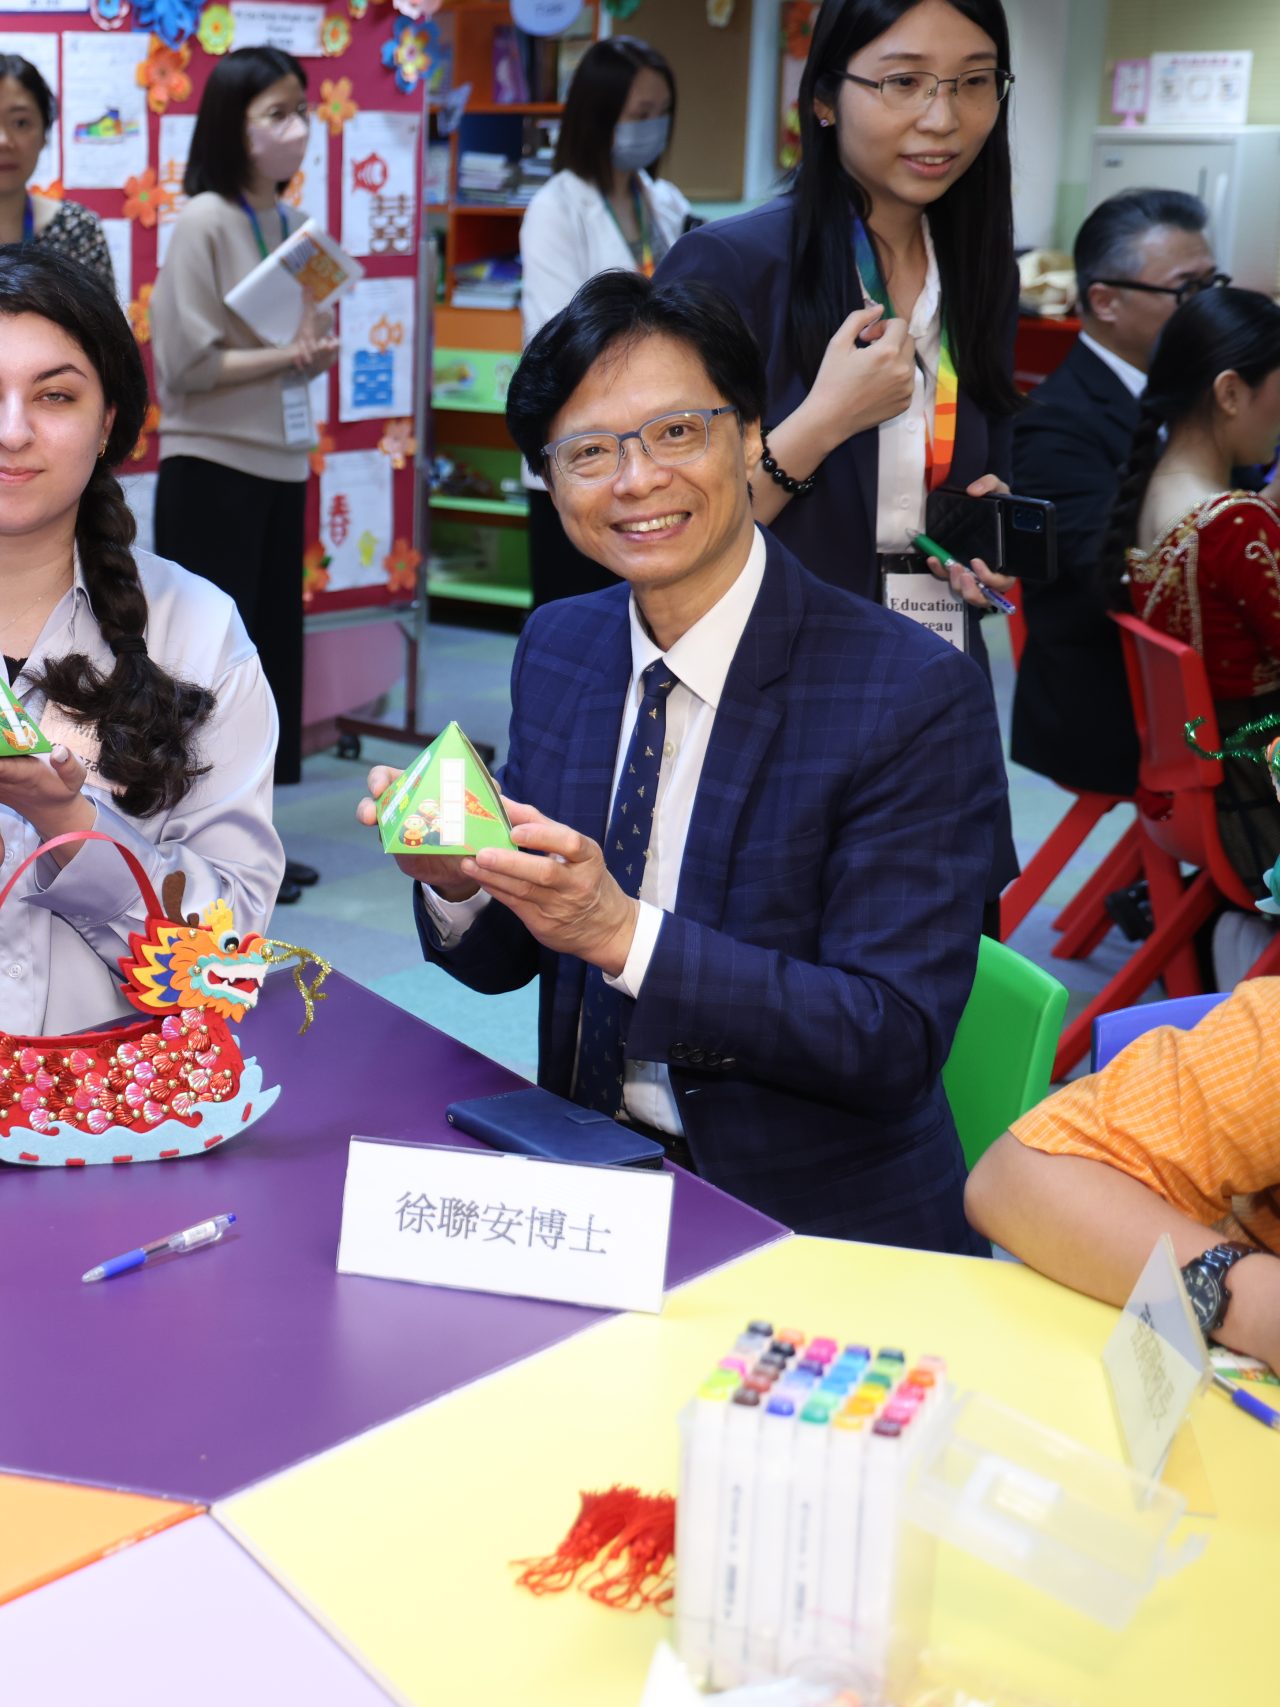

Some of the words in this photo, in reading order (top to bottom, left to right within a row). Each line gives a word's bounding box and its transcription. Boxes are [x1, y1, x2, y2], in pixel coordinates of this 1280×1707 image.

[890, 597, 963, 612] Education
[395, 1191, 612, 1255] 徐聯安博士
